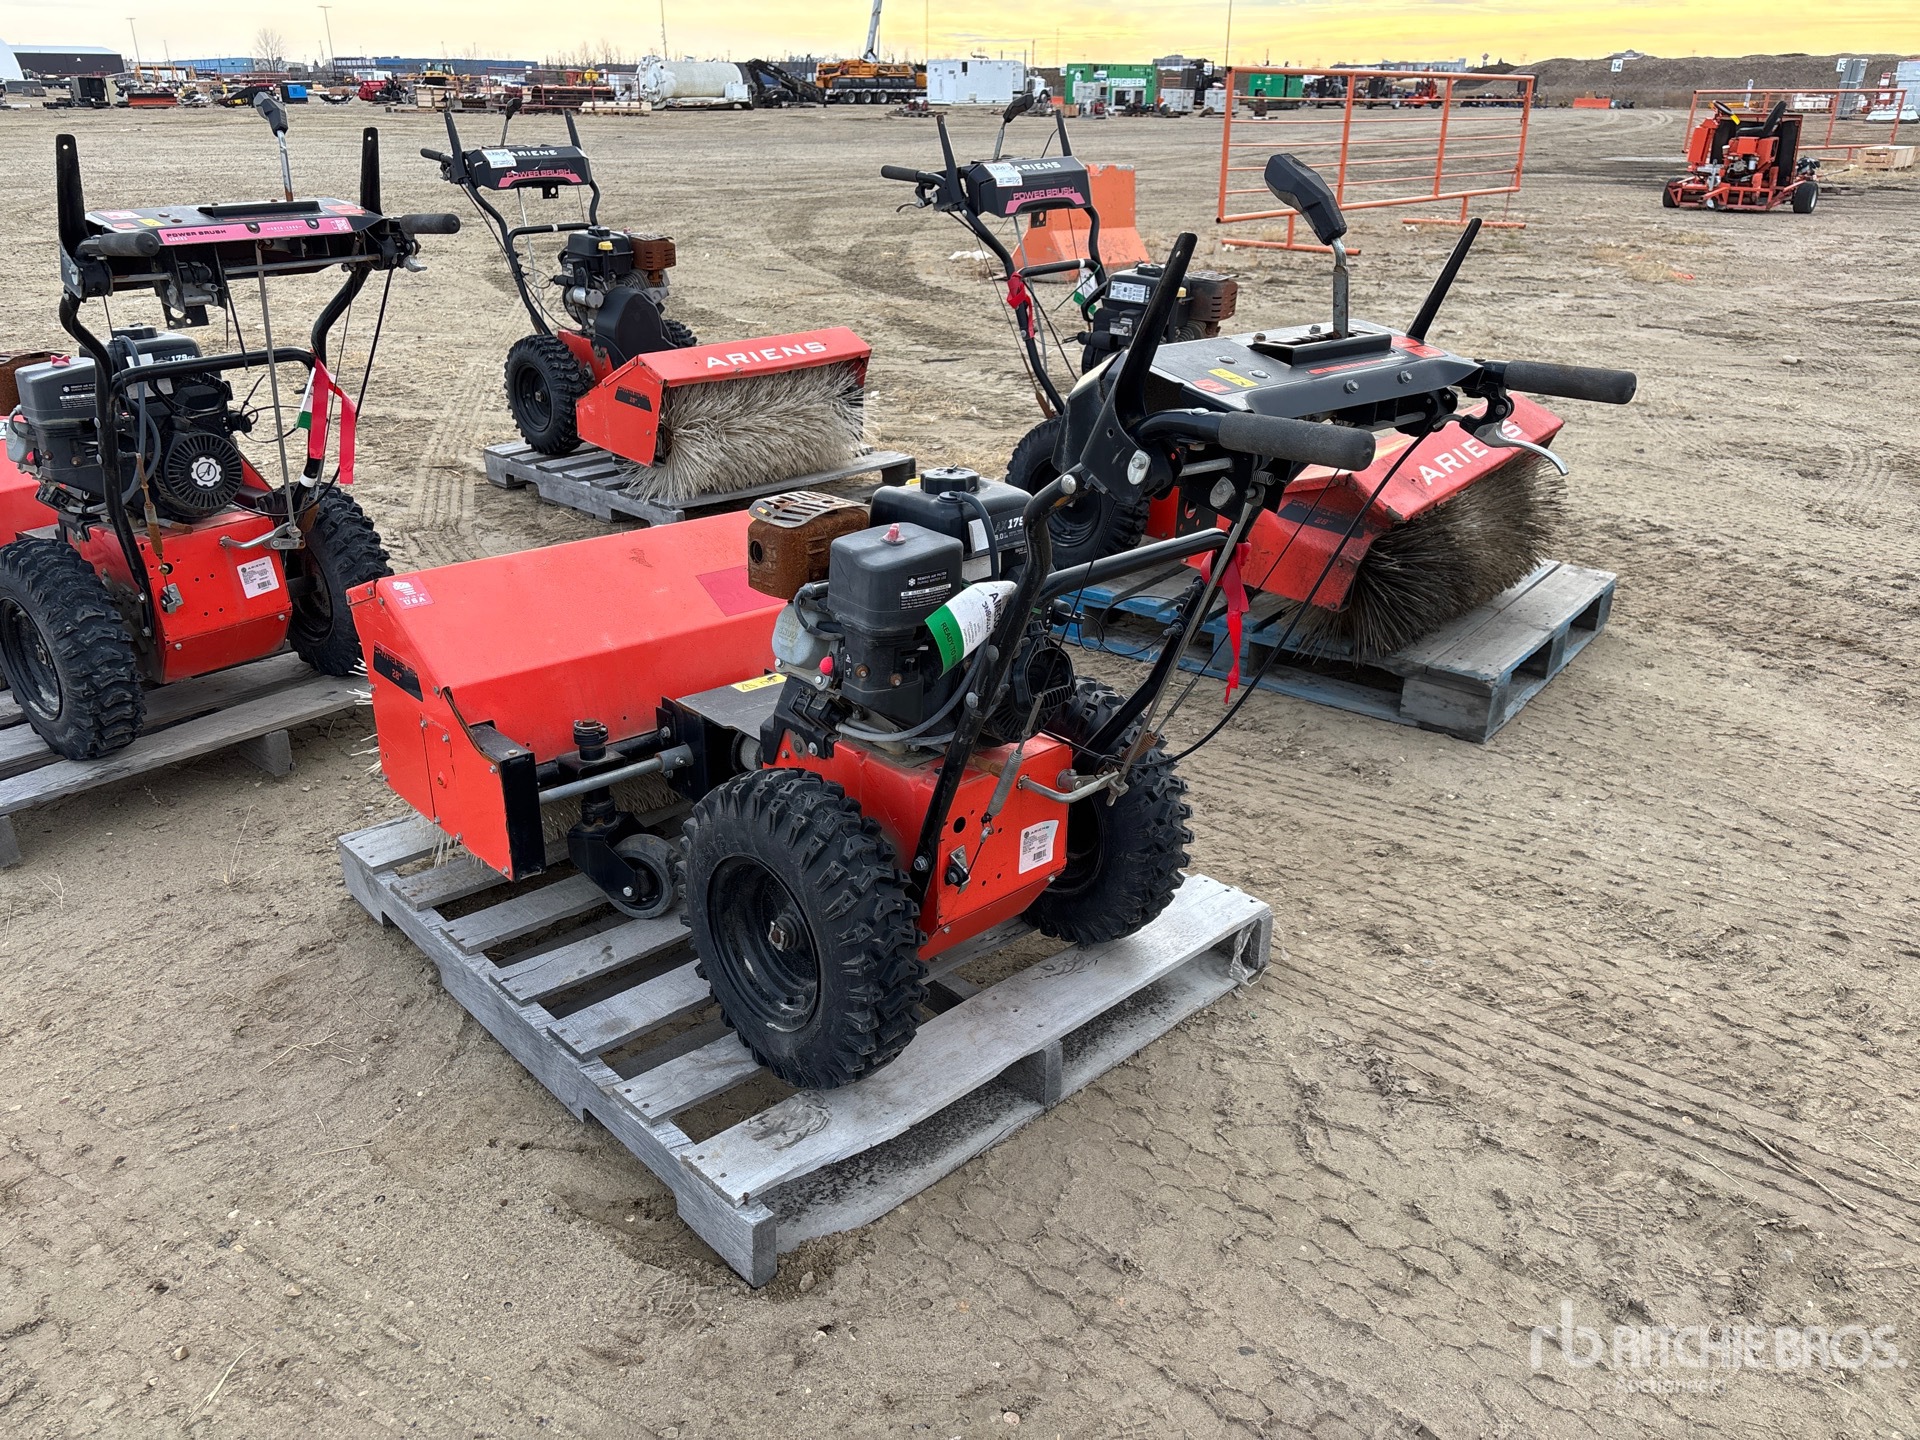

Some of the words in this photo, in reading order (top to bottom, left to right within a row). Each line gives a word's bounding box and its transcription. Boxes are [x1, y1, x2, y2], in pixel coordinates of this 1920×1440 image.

[540, 168, 571, 177] BRUSH
[1013, 189, 1046, 201] POWER
[1046, 186, 1075, 197] BRUSH
[706, 341, 827, 369] ARIENS
[1418, 420, 1523, 486] ARIES
[403, 596, 427, 606] USA
[940, 622, 953, 646] READY
